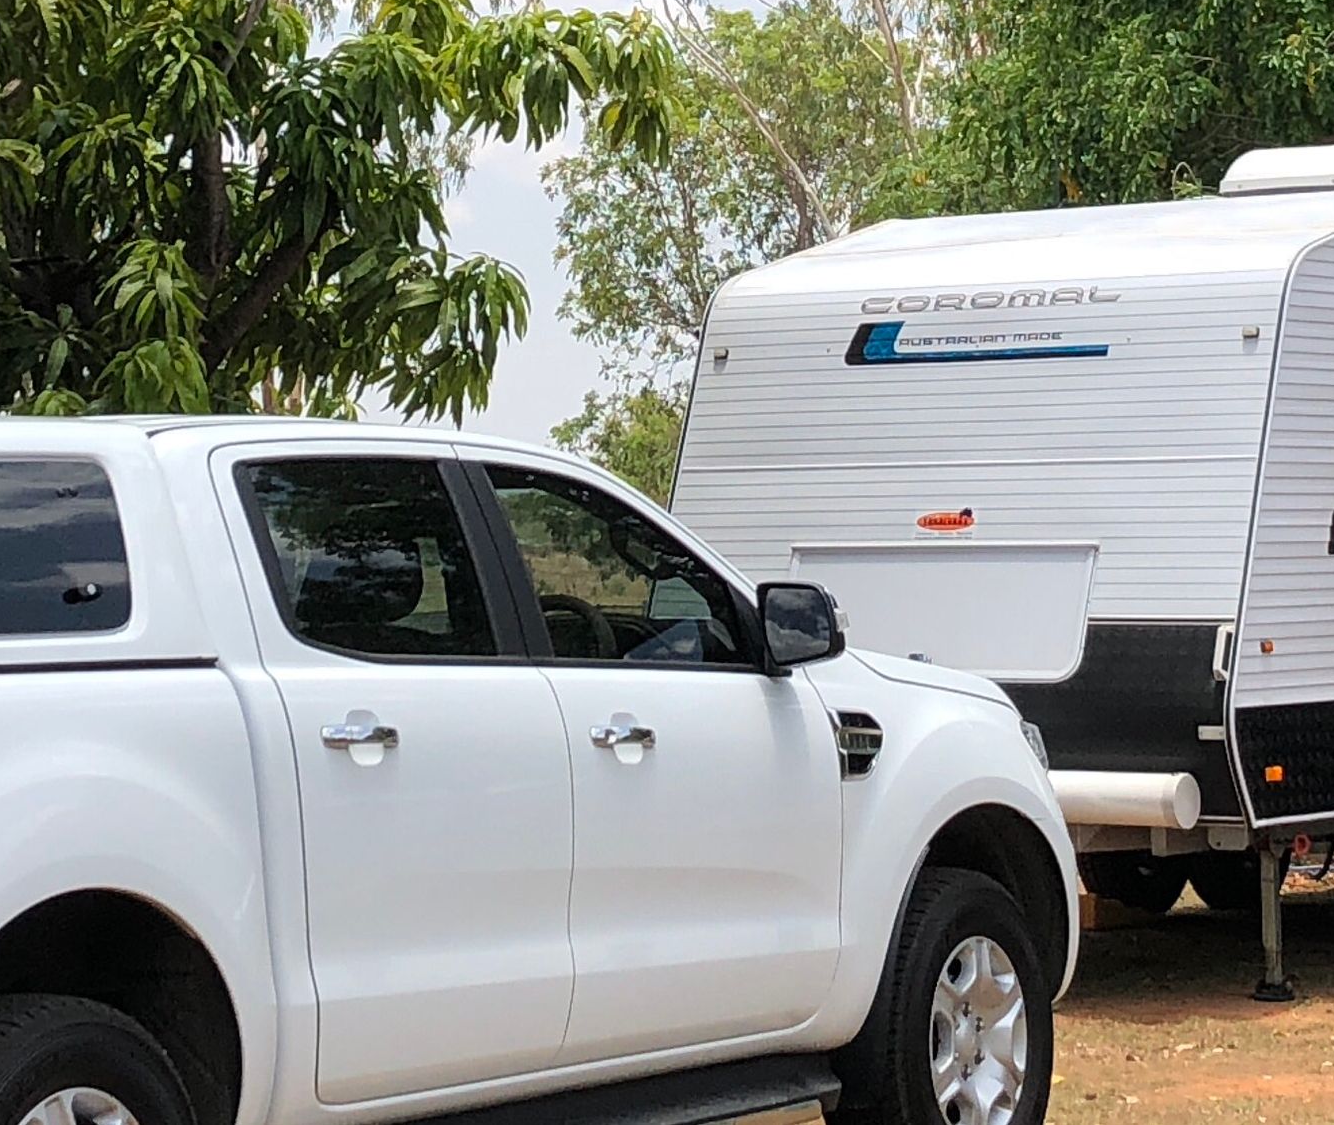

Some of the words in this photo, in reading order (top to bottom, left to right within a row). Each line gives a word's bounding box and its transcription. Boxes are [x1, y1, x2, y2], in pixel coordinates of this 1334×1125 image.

[861, 286, 1122, 315] COROMAL
[898, 334, 1006, 347] AUSTRALIAN
[1012, 331, 1063, 344] MADE
